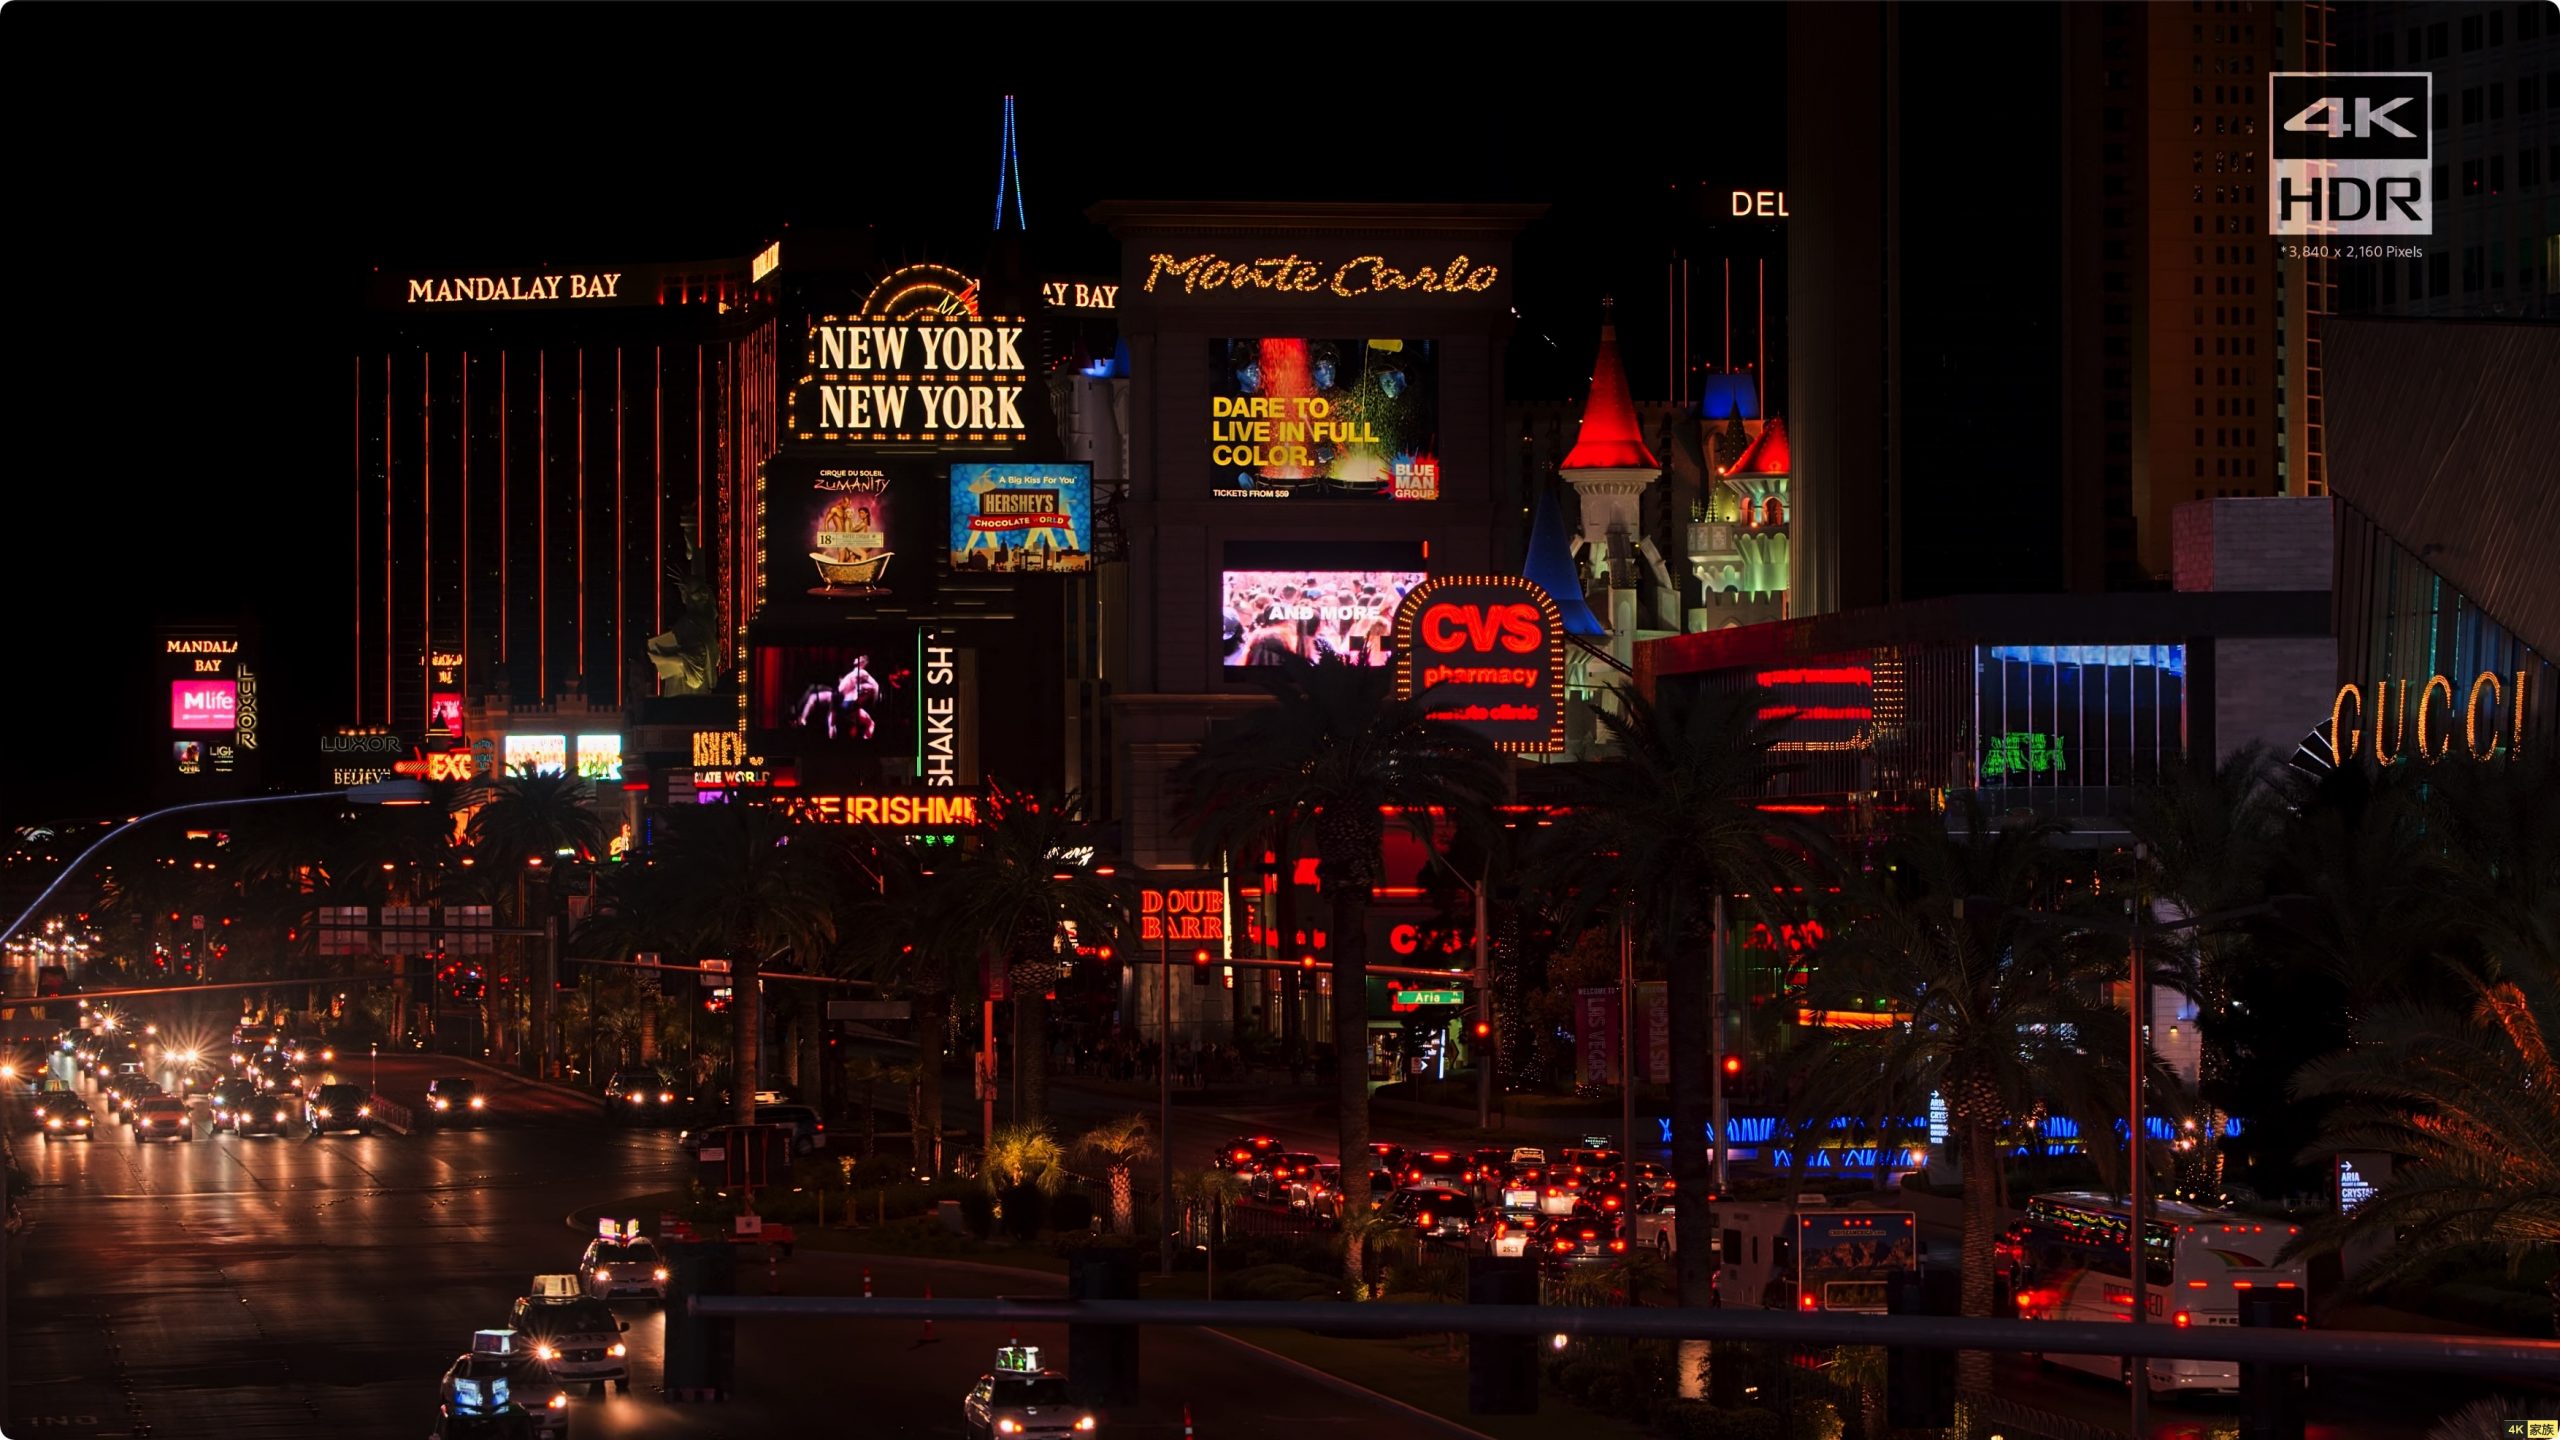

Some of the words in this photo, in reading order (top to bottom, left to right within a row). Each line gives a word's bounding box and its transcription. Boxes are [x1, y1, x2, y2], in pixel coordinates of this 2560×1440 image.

[1143, 252, 1328, 295] Monte
[1330, 254, 1499, 298] Carlo
[408, 275, 563, 303] MANDALAY
[571, 273, 622, 298] BAY
[1074, 284, 1120, 309] BAY
[819, 326, 909, 370] NEW
[917, 326, 1025, 371] YORK
[819, 386, 909, 430] NEW
[917, 386, 1025, 430] YORK
[1212, 396, 1285, 419] DARE
[1291, 396, 1330, 419] TO
[1212, 420, 1271, 443] LIVE
[1279, 420, 1306, 443] IN
[1312, 420, 1379, 443] FULL
[1212, 445, 1315, 468] COLOR.
[819, 469, 847, 478] CIRQUE
[847, 469, 859, 477] DU
[859, 469, 885, 477] SOLEIL
[998, 476, 1006, 485] A
[1007, 476, 1022, 486] Big
[1024, 476, 1041, 485] Kiss
[1043, 476, 1057, 485] For
[1395, 463, 1435, 476] BLUE
[1212, 488, 1248, 498] TICKETS
[1248, 488, 1274, 499] FROM
[1394, 489, 1435, 499] GROUP
[1395, 476, 1435, 489] MAN
[984, 494, 1054, 514] HERSHEY'S
[974, 517, 1031, 528] CHOCOLATE
[1268, 606, 1315, 621] AND
[1319, 606, 1380, 622] MORE
[1421, 602, 1543, 655] CVS
[195, 660, 222, 672] BAY
[927, 633, 954, 685] SH
[1423, 664, 1540, 690] pharmacy
[236, 664, 258, 749] LUXOR
[2331, 669, 2526, 768] GUCCI
[321, 735, 402, 752] LUXOR
[927, 697, 954, 786] SHAKE
[1415, 992, 1441, 1003] Aria
[1587, 997, 1607, 1029] LAS
[1587, 1030, 1608, 1081] VEGAS
[2341, 1172, 2360, 1182] ARIA
